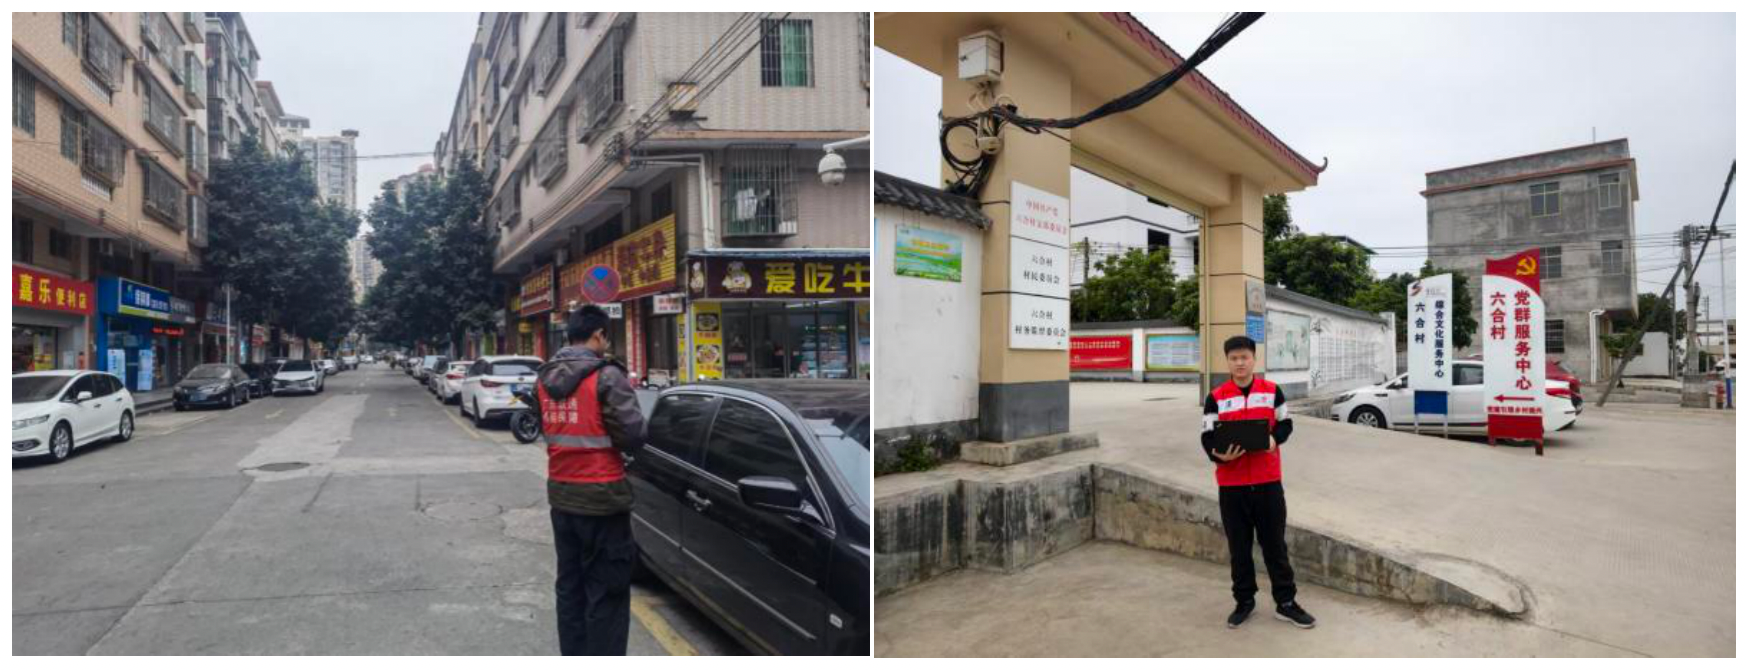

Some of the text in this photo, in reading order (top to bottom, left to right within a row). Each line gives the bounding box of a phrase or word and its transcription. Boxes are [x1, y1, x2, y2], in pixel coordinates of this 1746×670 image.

[1026, 200, 1058, 217] 中国共产党
[1023, 270, 1060, 285] 村民委员会
[1032, 254, 1052, 267] 六合村
[19, 273, 87, 309] 嘉乐便利店
[765, 262, 870, 294] 爱吃牛
[1031, 310, 1053, 320] 六合村
[1415, 302, 1425, 344] 六合村
[1490, 291, 1506, 340] 六合村
[1434, 300, 1444, 378] 综合文化服务中心
[1514, 289, 1532, 391] 党群服务中心
